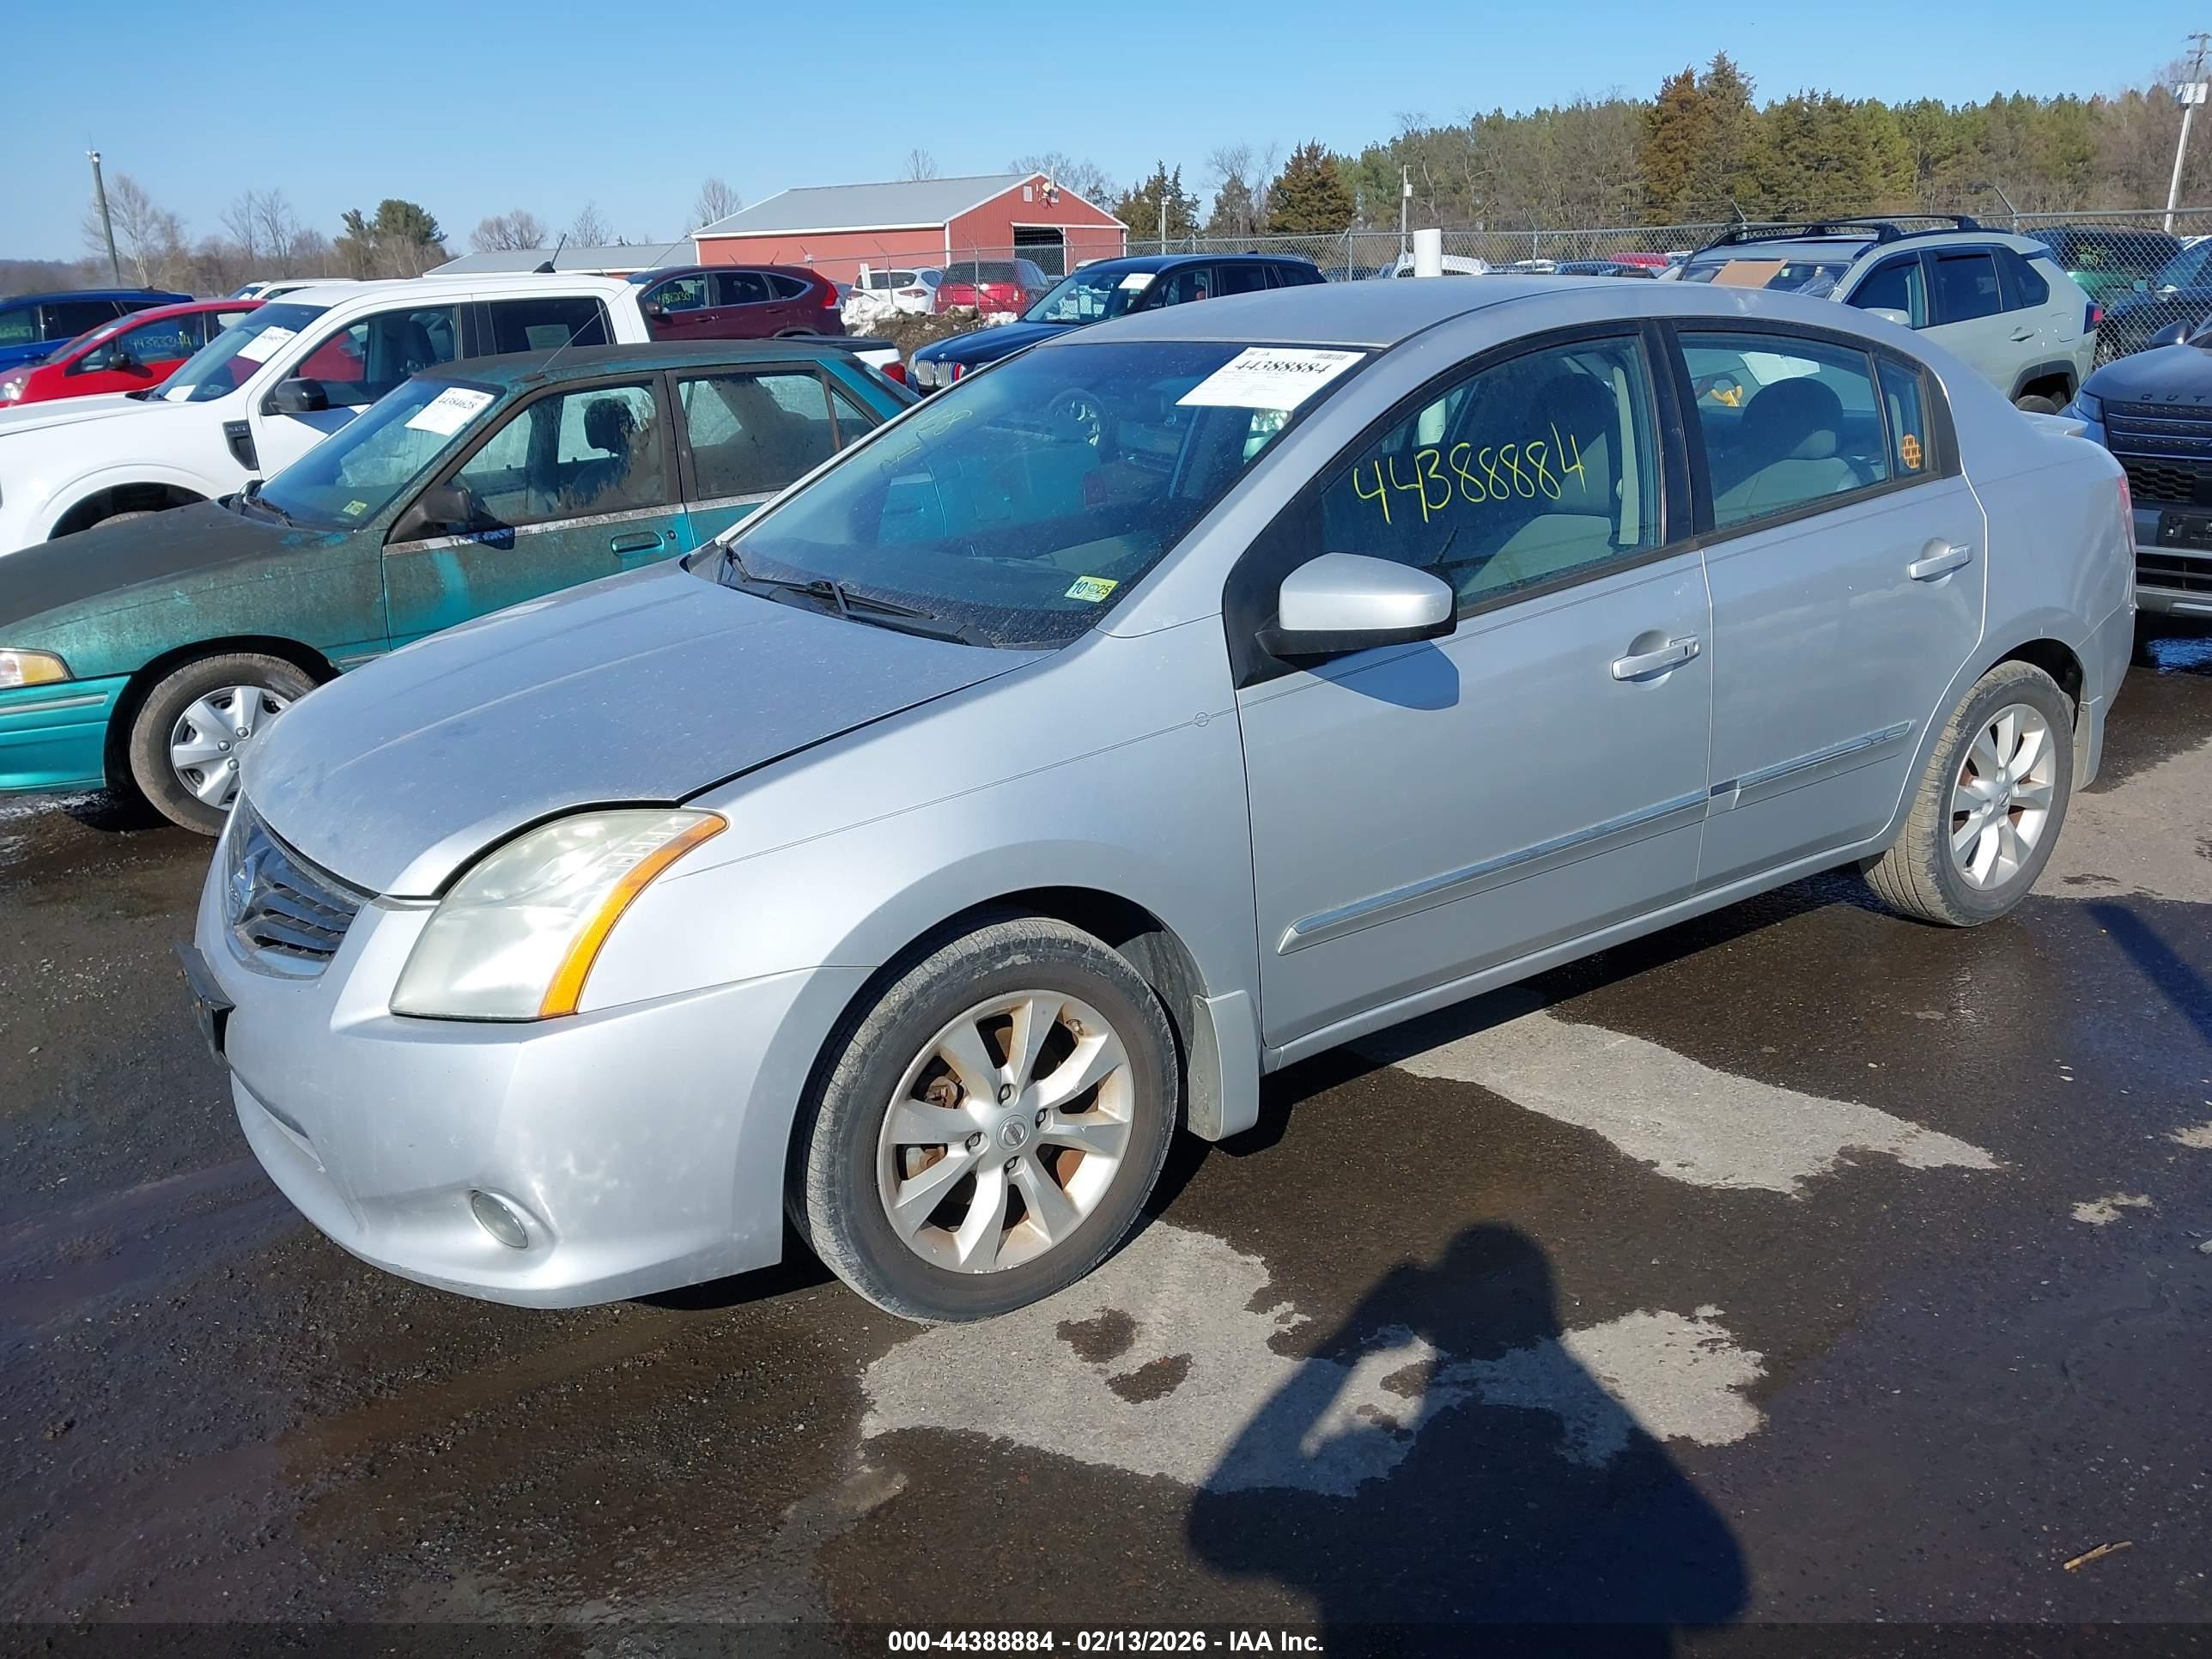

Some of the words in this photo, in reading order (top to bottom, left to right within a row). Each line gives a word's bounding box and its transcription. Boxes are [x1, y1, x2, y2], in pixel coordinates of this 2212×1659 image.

[1235, 360, 1333, 374] 44388884
[1353, 421, 1587, 526] 44388884
[1071, 580, 1089, 594] 10
[1096, 585, 1113, 595] 25
